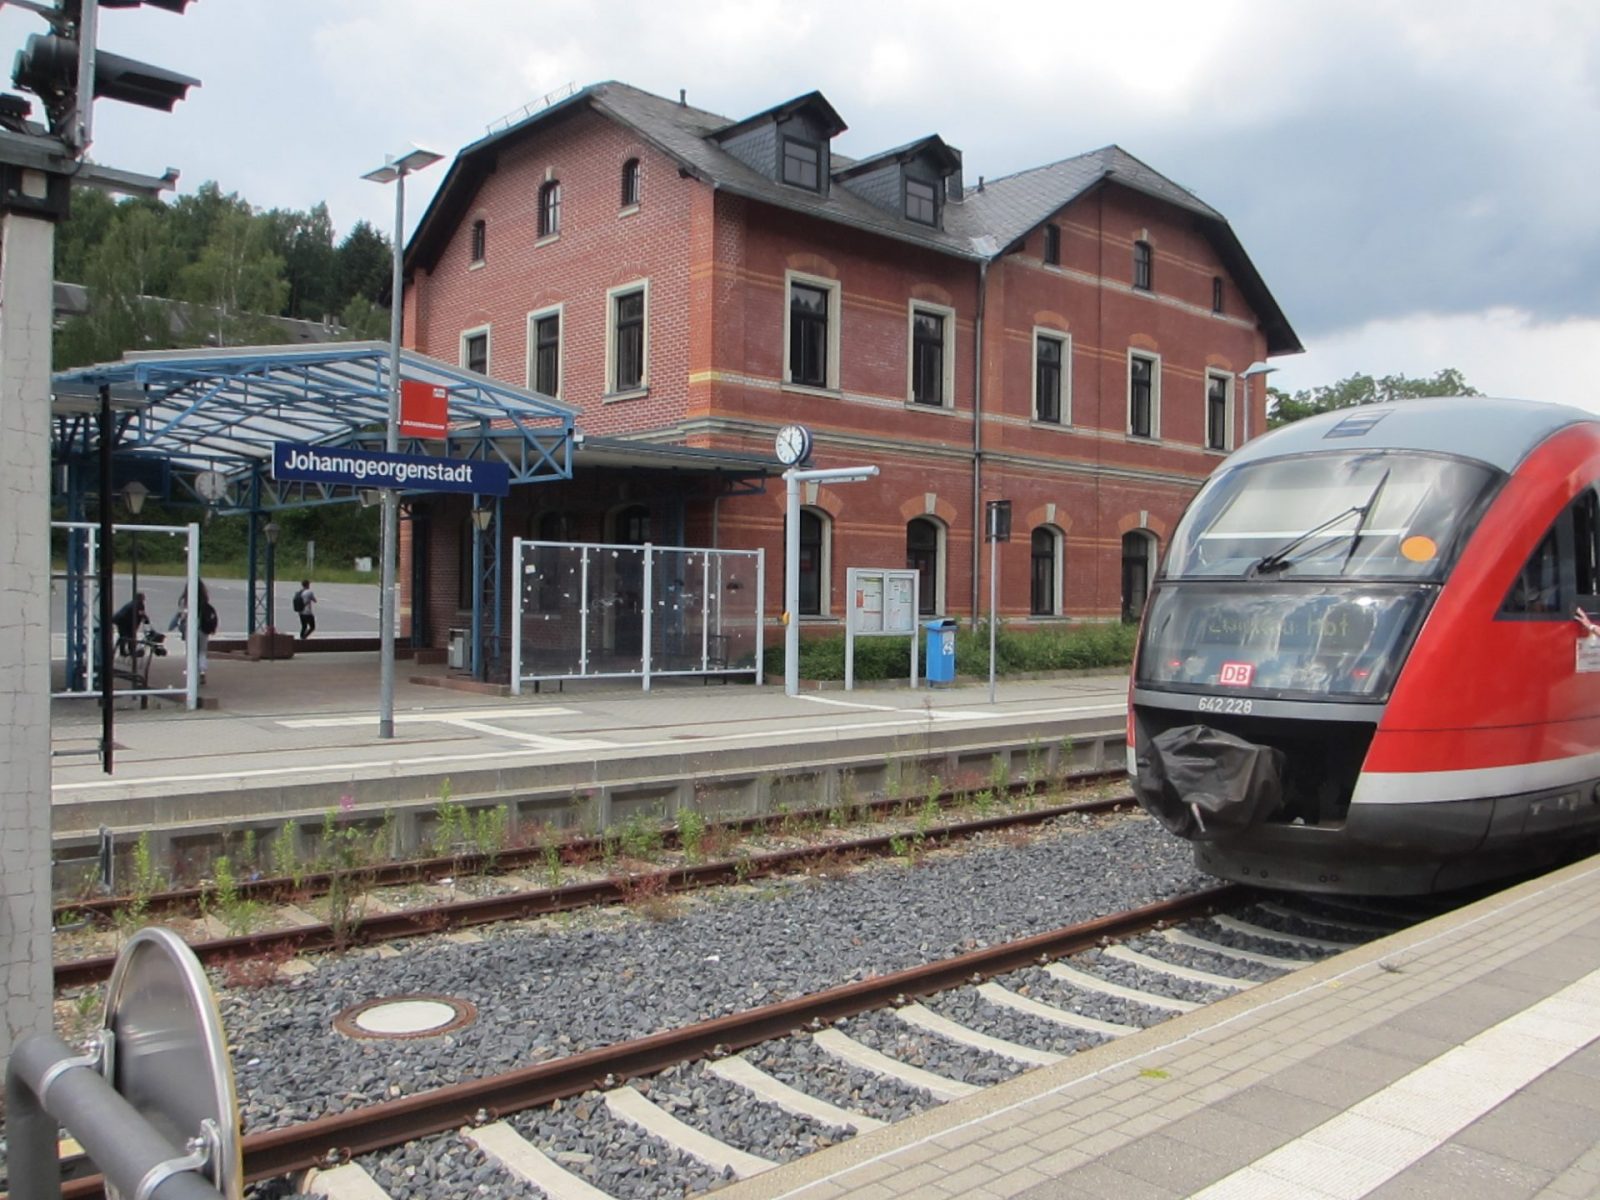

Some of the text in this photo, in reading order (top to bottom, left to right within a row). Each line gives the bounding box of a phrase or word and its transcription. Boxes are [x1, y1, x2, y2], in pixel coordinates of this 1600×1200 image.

[285, 450, 472, 483] Johanngeorgenstadt
[1223, 666, 1248, 682] DB
[1198, 697, 1252, 714] 642 228
